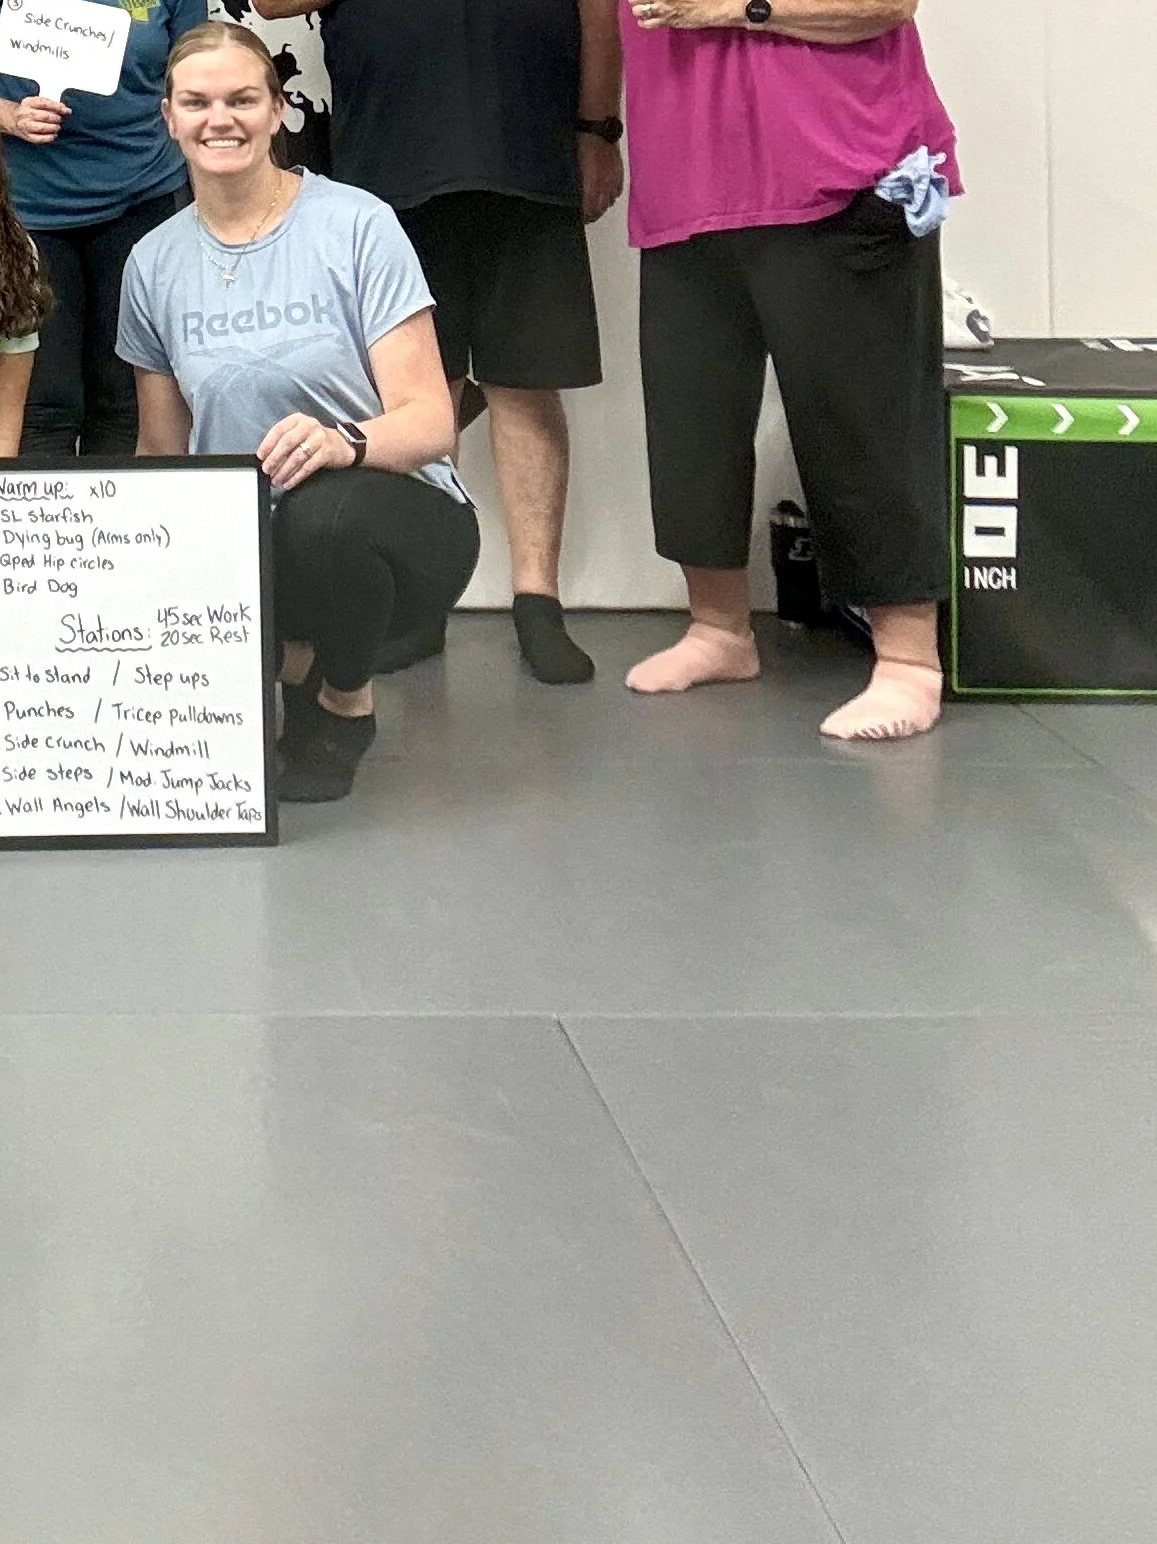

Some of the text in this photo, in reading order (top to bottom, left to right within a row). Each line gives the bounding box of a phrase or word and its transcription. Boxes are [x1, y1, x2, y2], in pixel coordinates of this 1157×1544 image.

[24, 12, 51, 27] Side
[10, 37, 70, 59] Windmills
[3, 529, 51, 551] Dying
[55, 529, 84, 551] bug
[43, 553, 65, 572] Hip
[3, 577, 37, 595] Bird
[47, 578, 78, 598] Dog
[963, 566, 1017, 590] INCH
[206, 602, 252, 624] Work
[210, 625, 250, 645] Rest
[25, 664, 41, 684] to
[134, 664, 173, 691] Step
[179, 672, 210, 690] ups
[3, 700, 75, 721] Punches
[111, 702, 163, 725] Tricep
[4, 734, 39, 751] Side
[129, 738, 210, 759] Windmill
[2, 765, 36, 783] Side
[160, 768, 204, 796] Jump
[206, 771, 252, 793] Jacks
[4, 796, 43, 816] Wall
[53, 796, 111, 819] Angels
[165, 798, 233, 822] Shoulder
